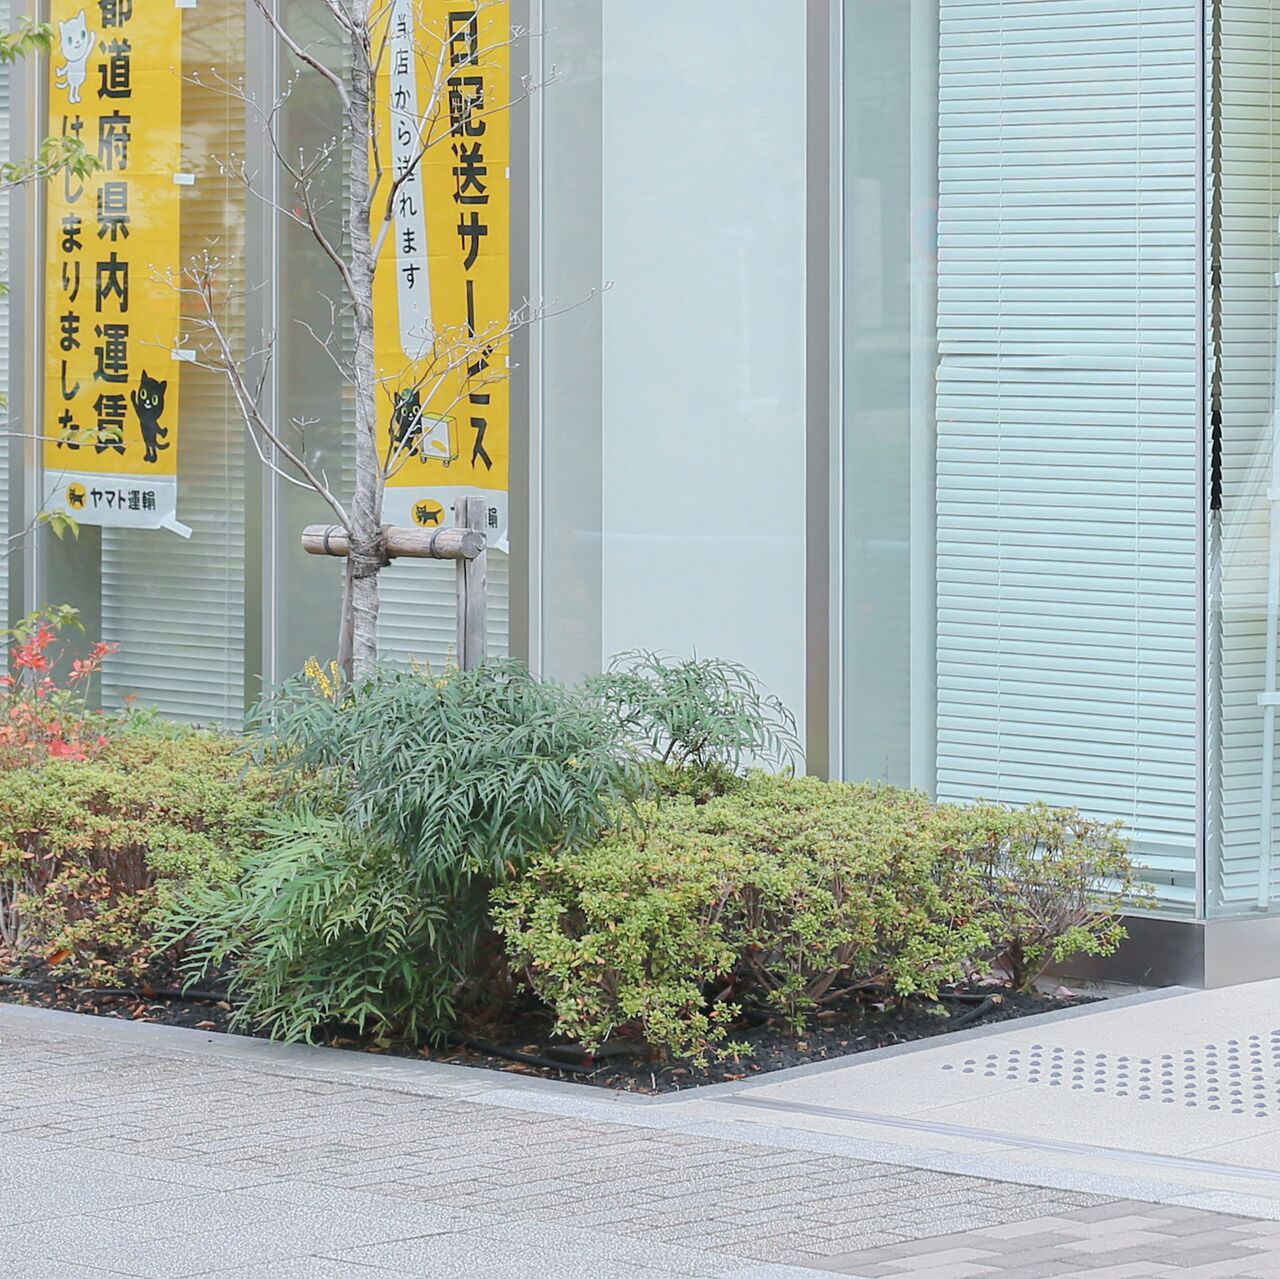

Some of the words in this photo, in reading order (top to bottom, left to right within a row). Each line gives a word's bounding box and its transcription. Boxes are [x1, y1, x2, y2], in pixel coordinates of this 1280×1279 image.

[90, 487, 156, 511] ヤマト運輸
